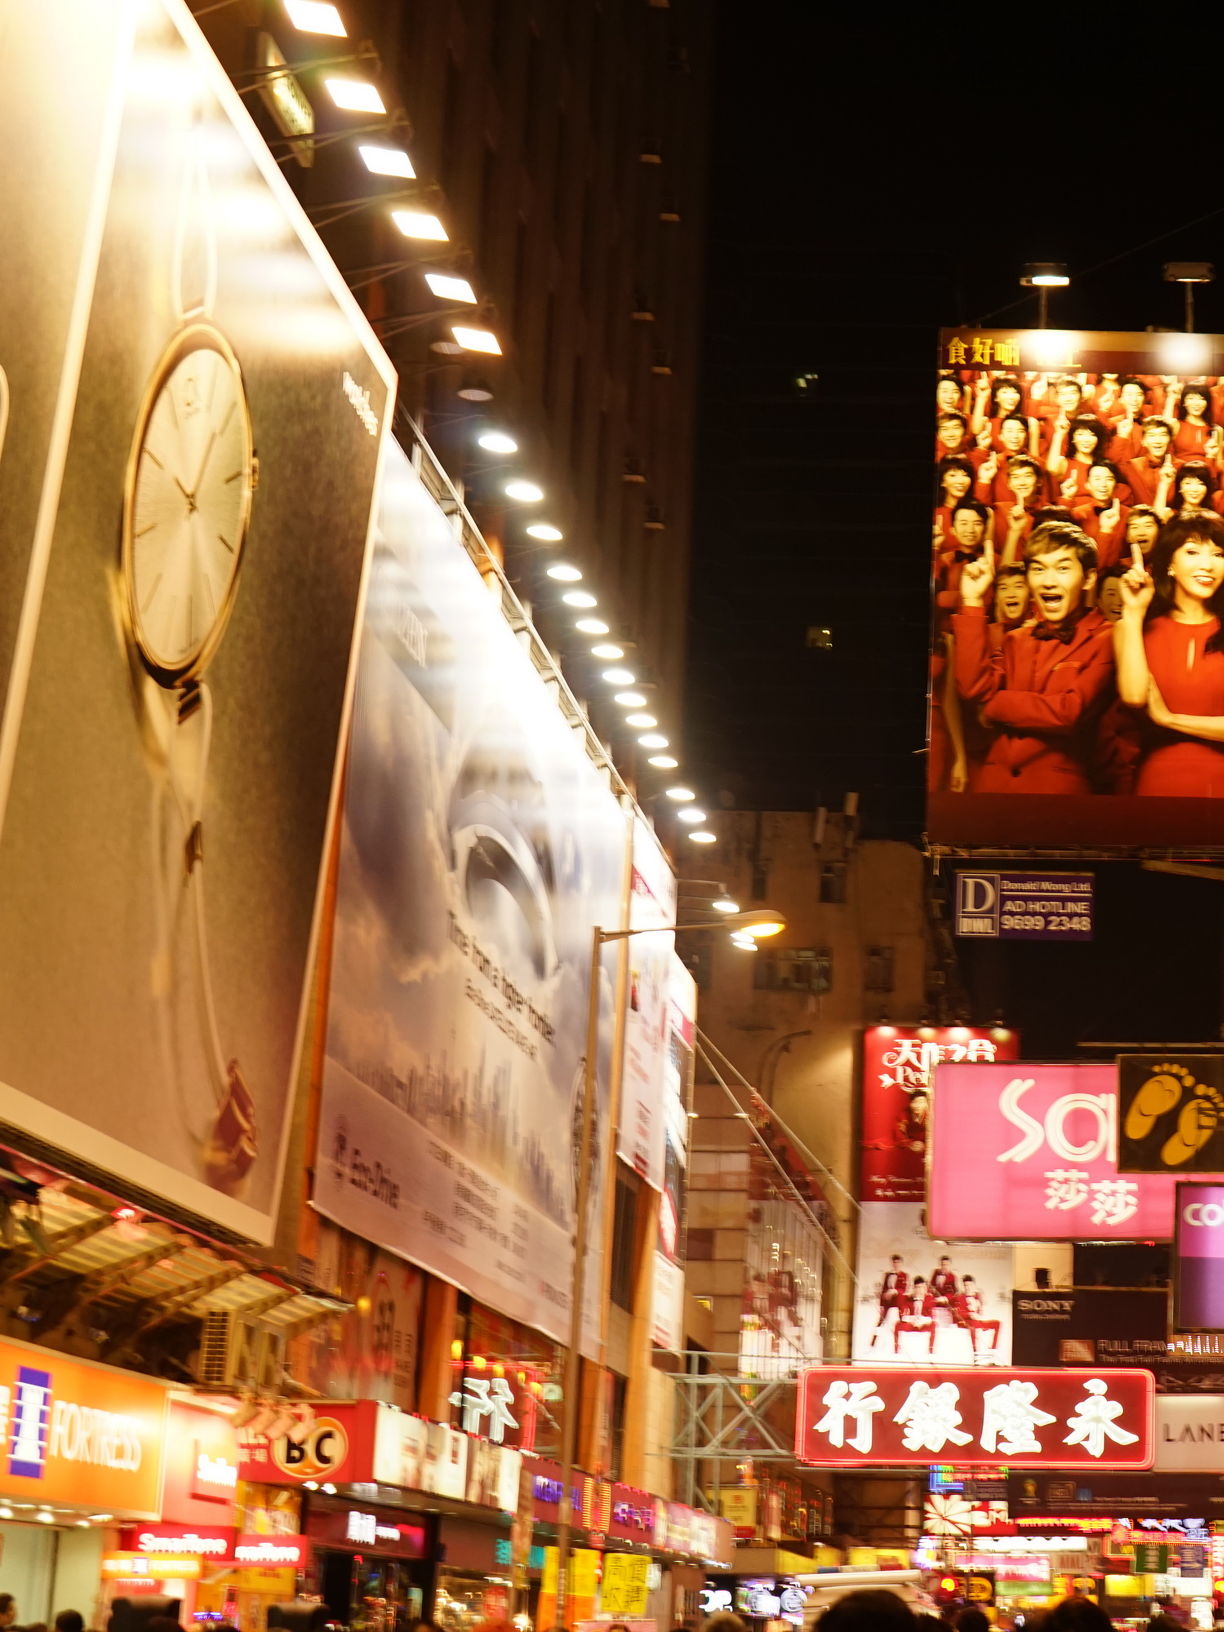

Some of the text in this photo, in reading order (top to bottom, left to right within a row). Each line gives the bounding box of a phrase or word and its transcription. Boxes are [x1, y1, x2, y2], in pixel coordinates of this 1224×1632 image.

[962, 878, 996, 912] D
[1028, 901, 1091, 913] HOTLINE
[1044, 1168, 1138, 1226] 莎莎
[1017, 1299, 1075, 1312] SONY
[50, 1400, 142, 1472] FORTRESS
